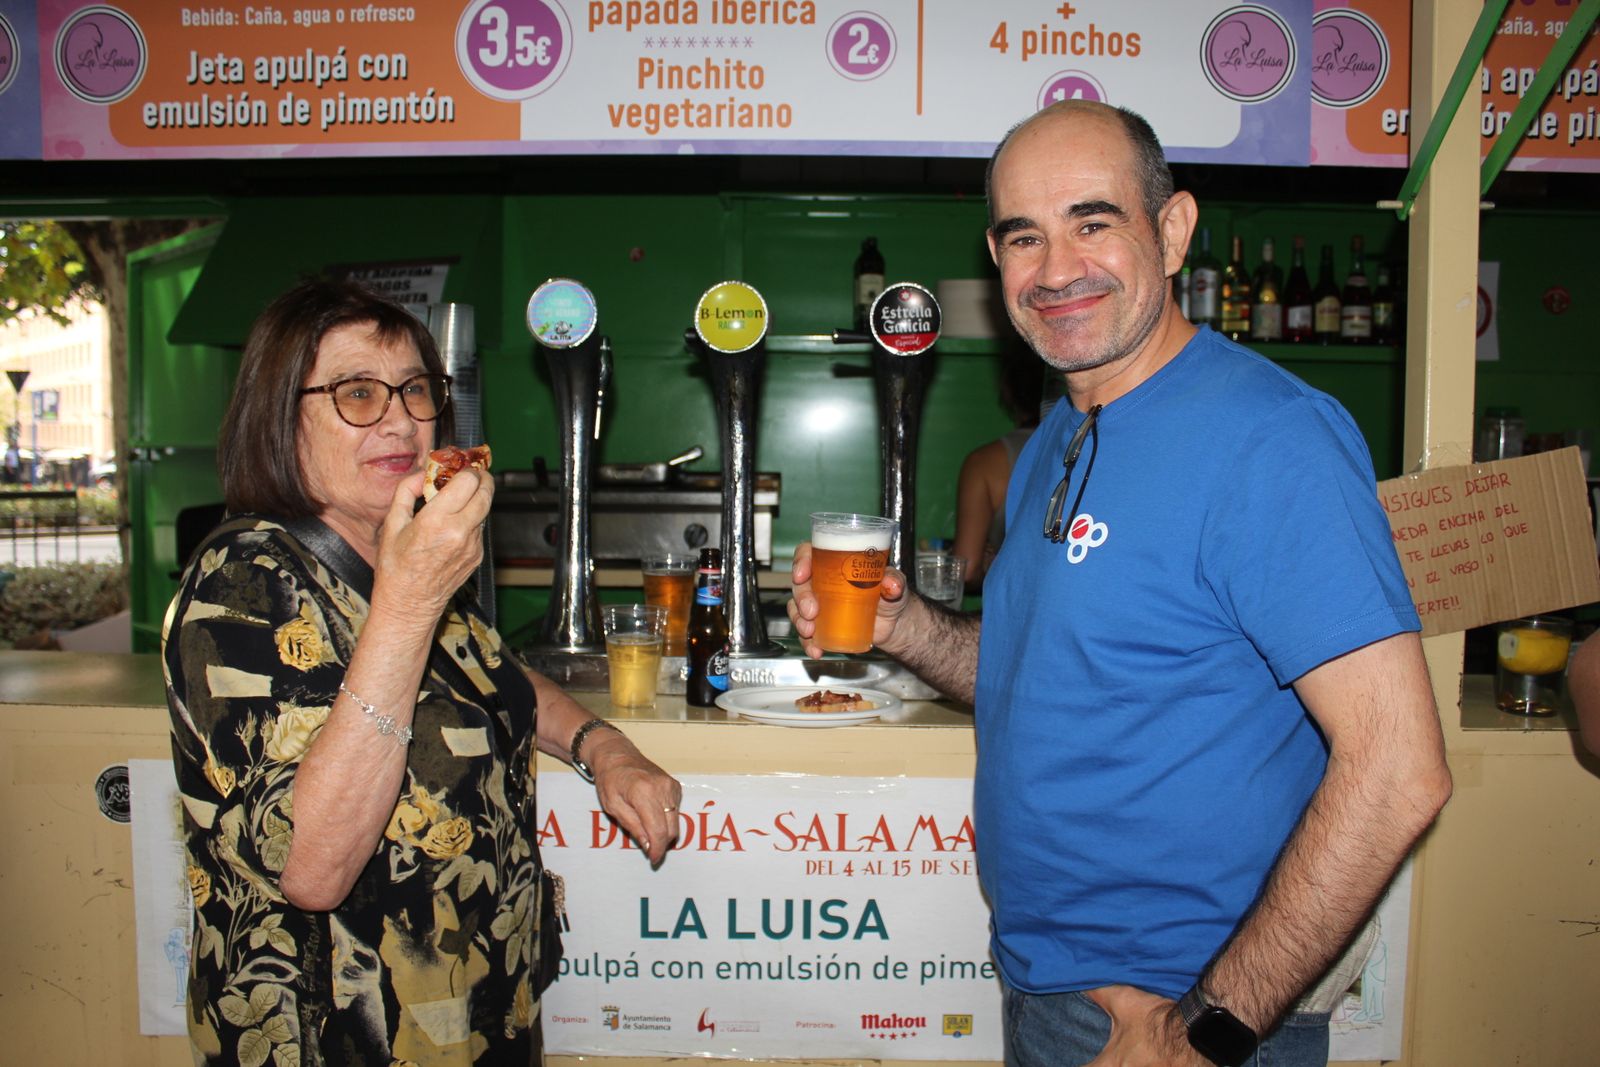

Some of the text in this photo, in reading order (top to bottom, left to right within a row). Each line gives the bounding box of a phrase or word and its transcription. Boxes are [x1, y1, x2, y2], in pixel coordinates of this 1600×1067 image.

[181, 4, 415, 27] Bebida: Caña, agua o refresco
[588, 0, 698, 32] papada
[1497, 17, 1538, 36] aña,
[848, 24, 879, 65] 2€
[990, 22, 1141, 61] 4 pinchos
[186, 47, 408, 87] Jeta apulpá con
[1219, 47, 1284, 70] La Luisa
[1339, 53, 1376, 77] Luisa
[638, 57, 765, 90] Pinchito
[143, 88, 454, 131] emulsión de pimentón
[607, 99, 793, 135] vegetariano
[881, 305, 933, 320] Estrella
[883, 319, 931, 334] Galicia
[1465, 472, 1512, 498] DEJAR
[1438, 509, 1486, 532] ENCIMA
[1494, 503, 1519, 518] DEL
[1405, 550, 1424, 562] TE
[1430, 537, 1470, 558] LLEVAS
[1504, 522, 1529, 539] QUE
[1426, 570, 1441, 585] EL
[1449, 560, 1480, 576] VASO
[806, 860, 838, 876] DEL
[843, 859, 854, 877] 4
[861, 859, 888, 876] AL
[892, 859, 911, 877] 15
[921, 859, 943, 875] DE
[639, 896, 890, 941] LA LUISA
[651, 959, 704, 980] con
[716, 953, 861, 981] emulsión
[873, 955, 909, 980] de
[622, 1014, 672, 1023] Ayuntamiento
[633, 1022, 672, 1032] Salamanca
[861, 1013, 927, 1030] Mahou
